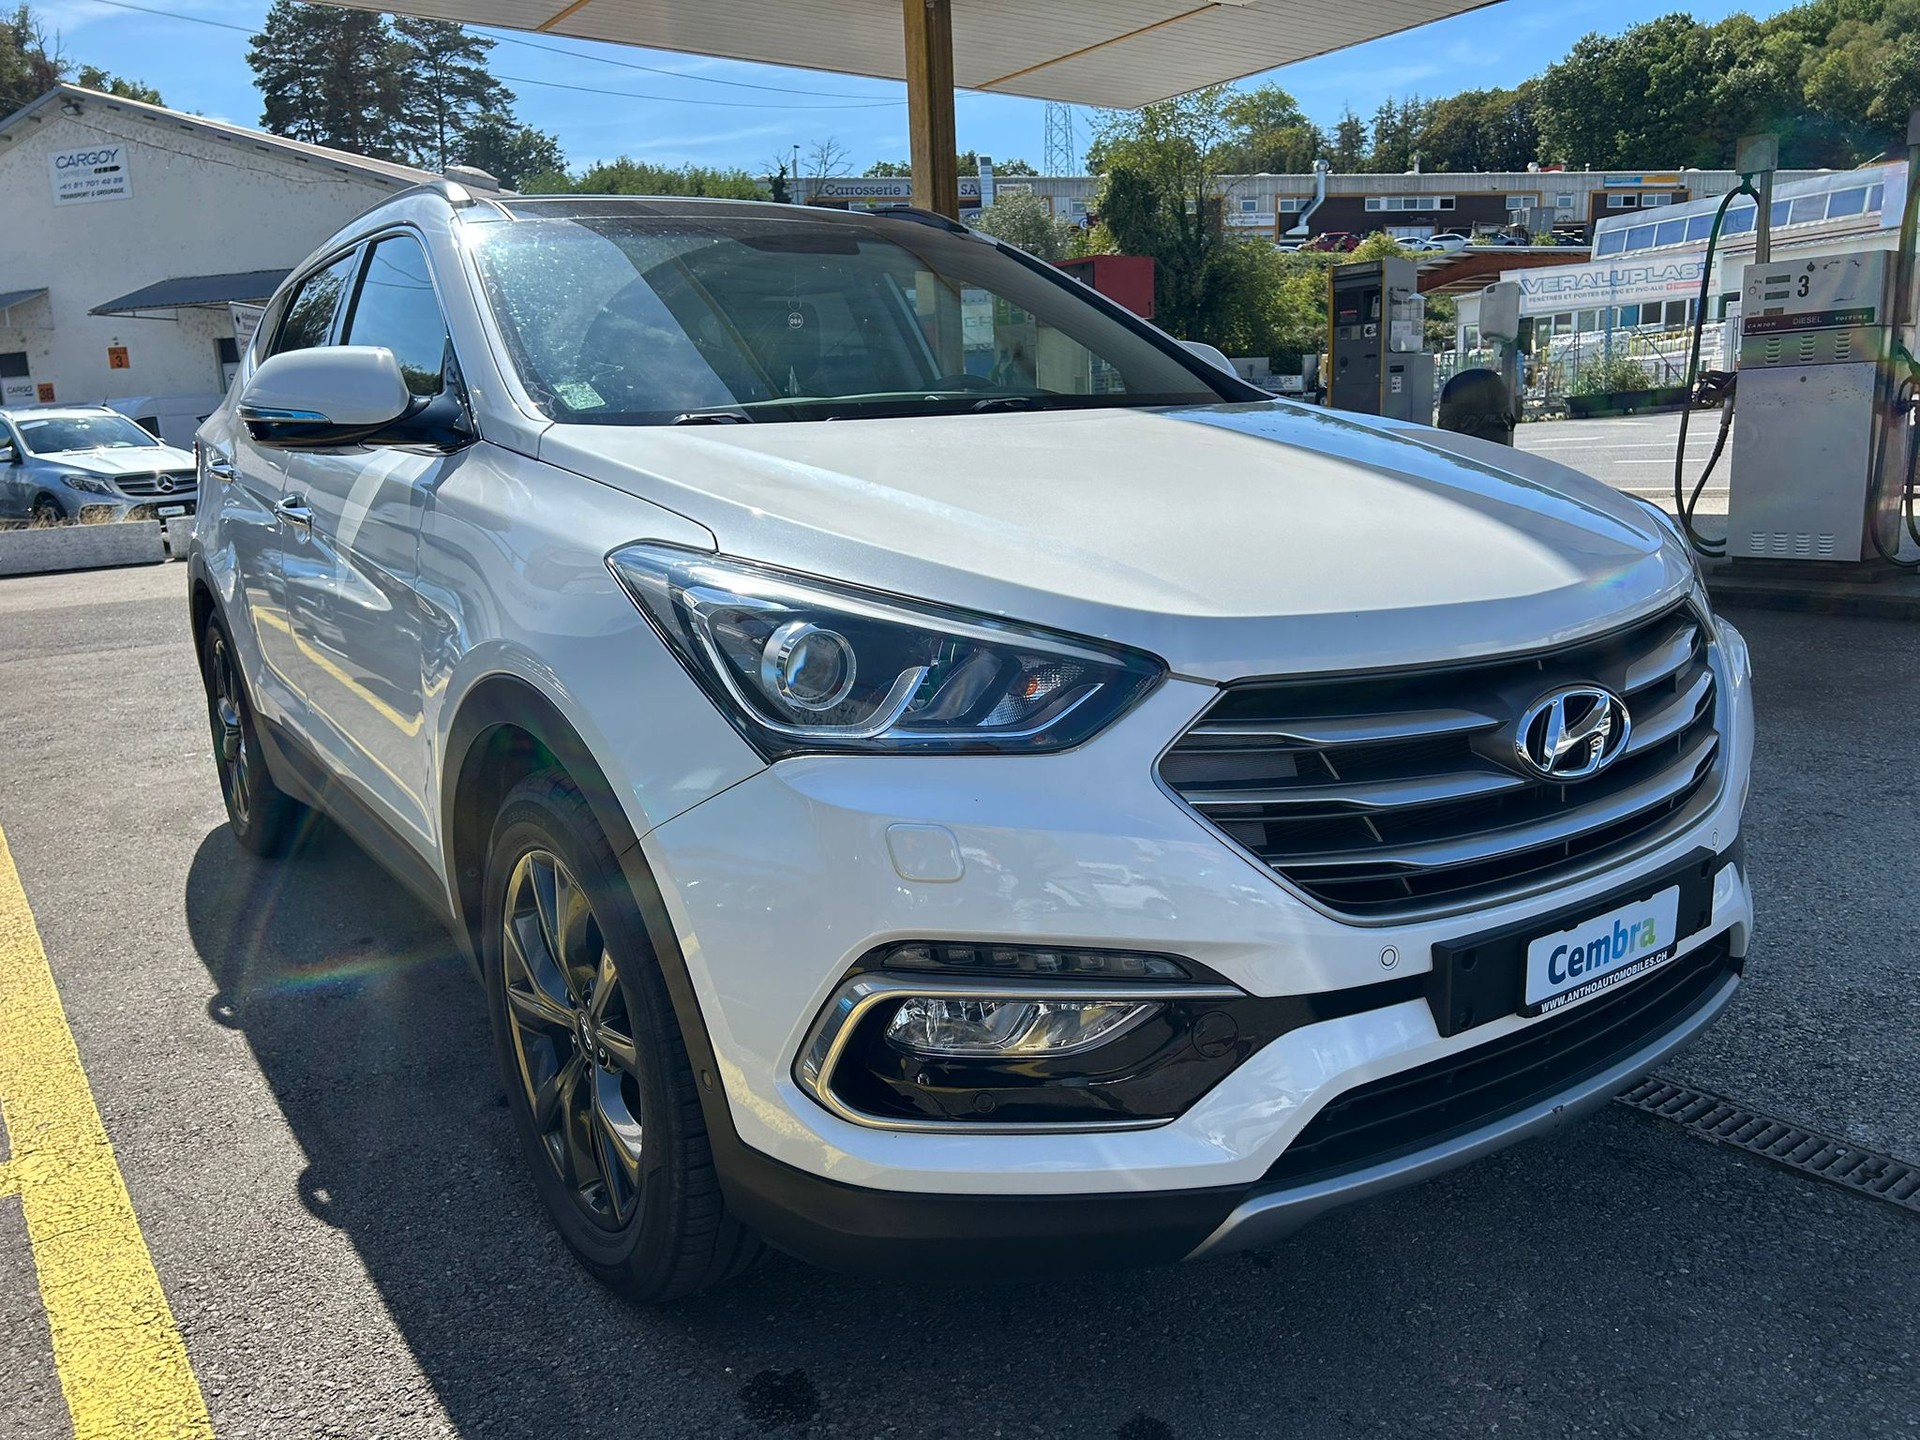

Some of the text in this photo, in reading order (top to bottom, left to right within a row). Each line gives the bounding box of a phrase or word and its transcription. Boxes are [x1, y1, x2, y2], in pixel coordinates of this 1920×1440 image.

[55, 149, 119, 169] CARGOY
[825, 183, 901, 196] Carrosserie
[960, 184, 978, 196] SA
[1797, 274, 1810, 298] 3
[1792, 316, 1823, 325] DIESEL
[115, 355, 123, 368] 3
[1547, 917, 1656, 985] Cembra
[1540, 950, 1668, 1014] WWW.ANTHOAUTOMOBILES.CH
